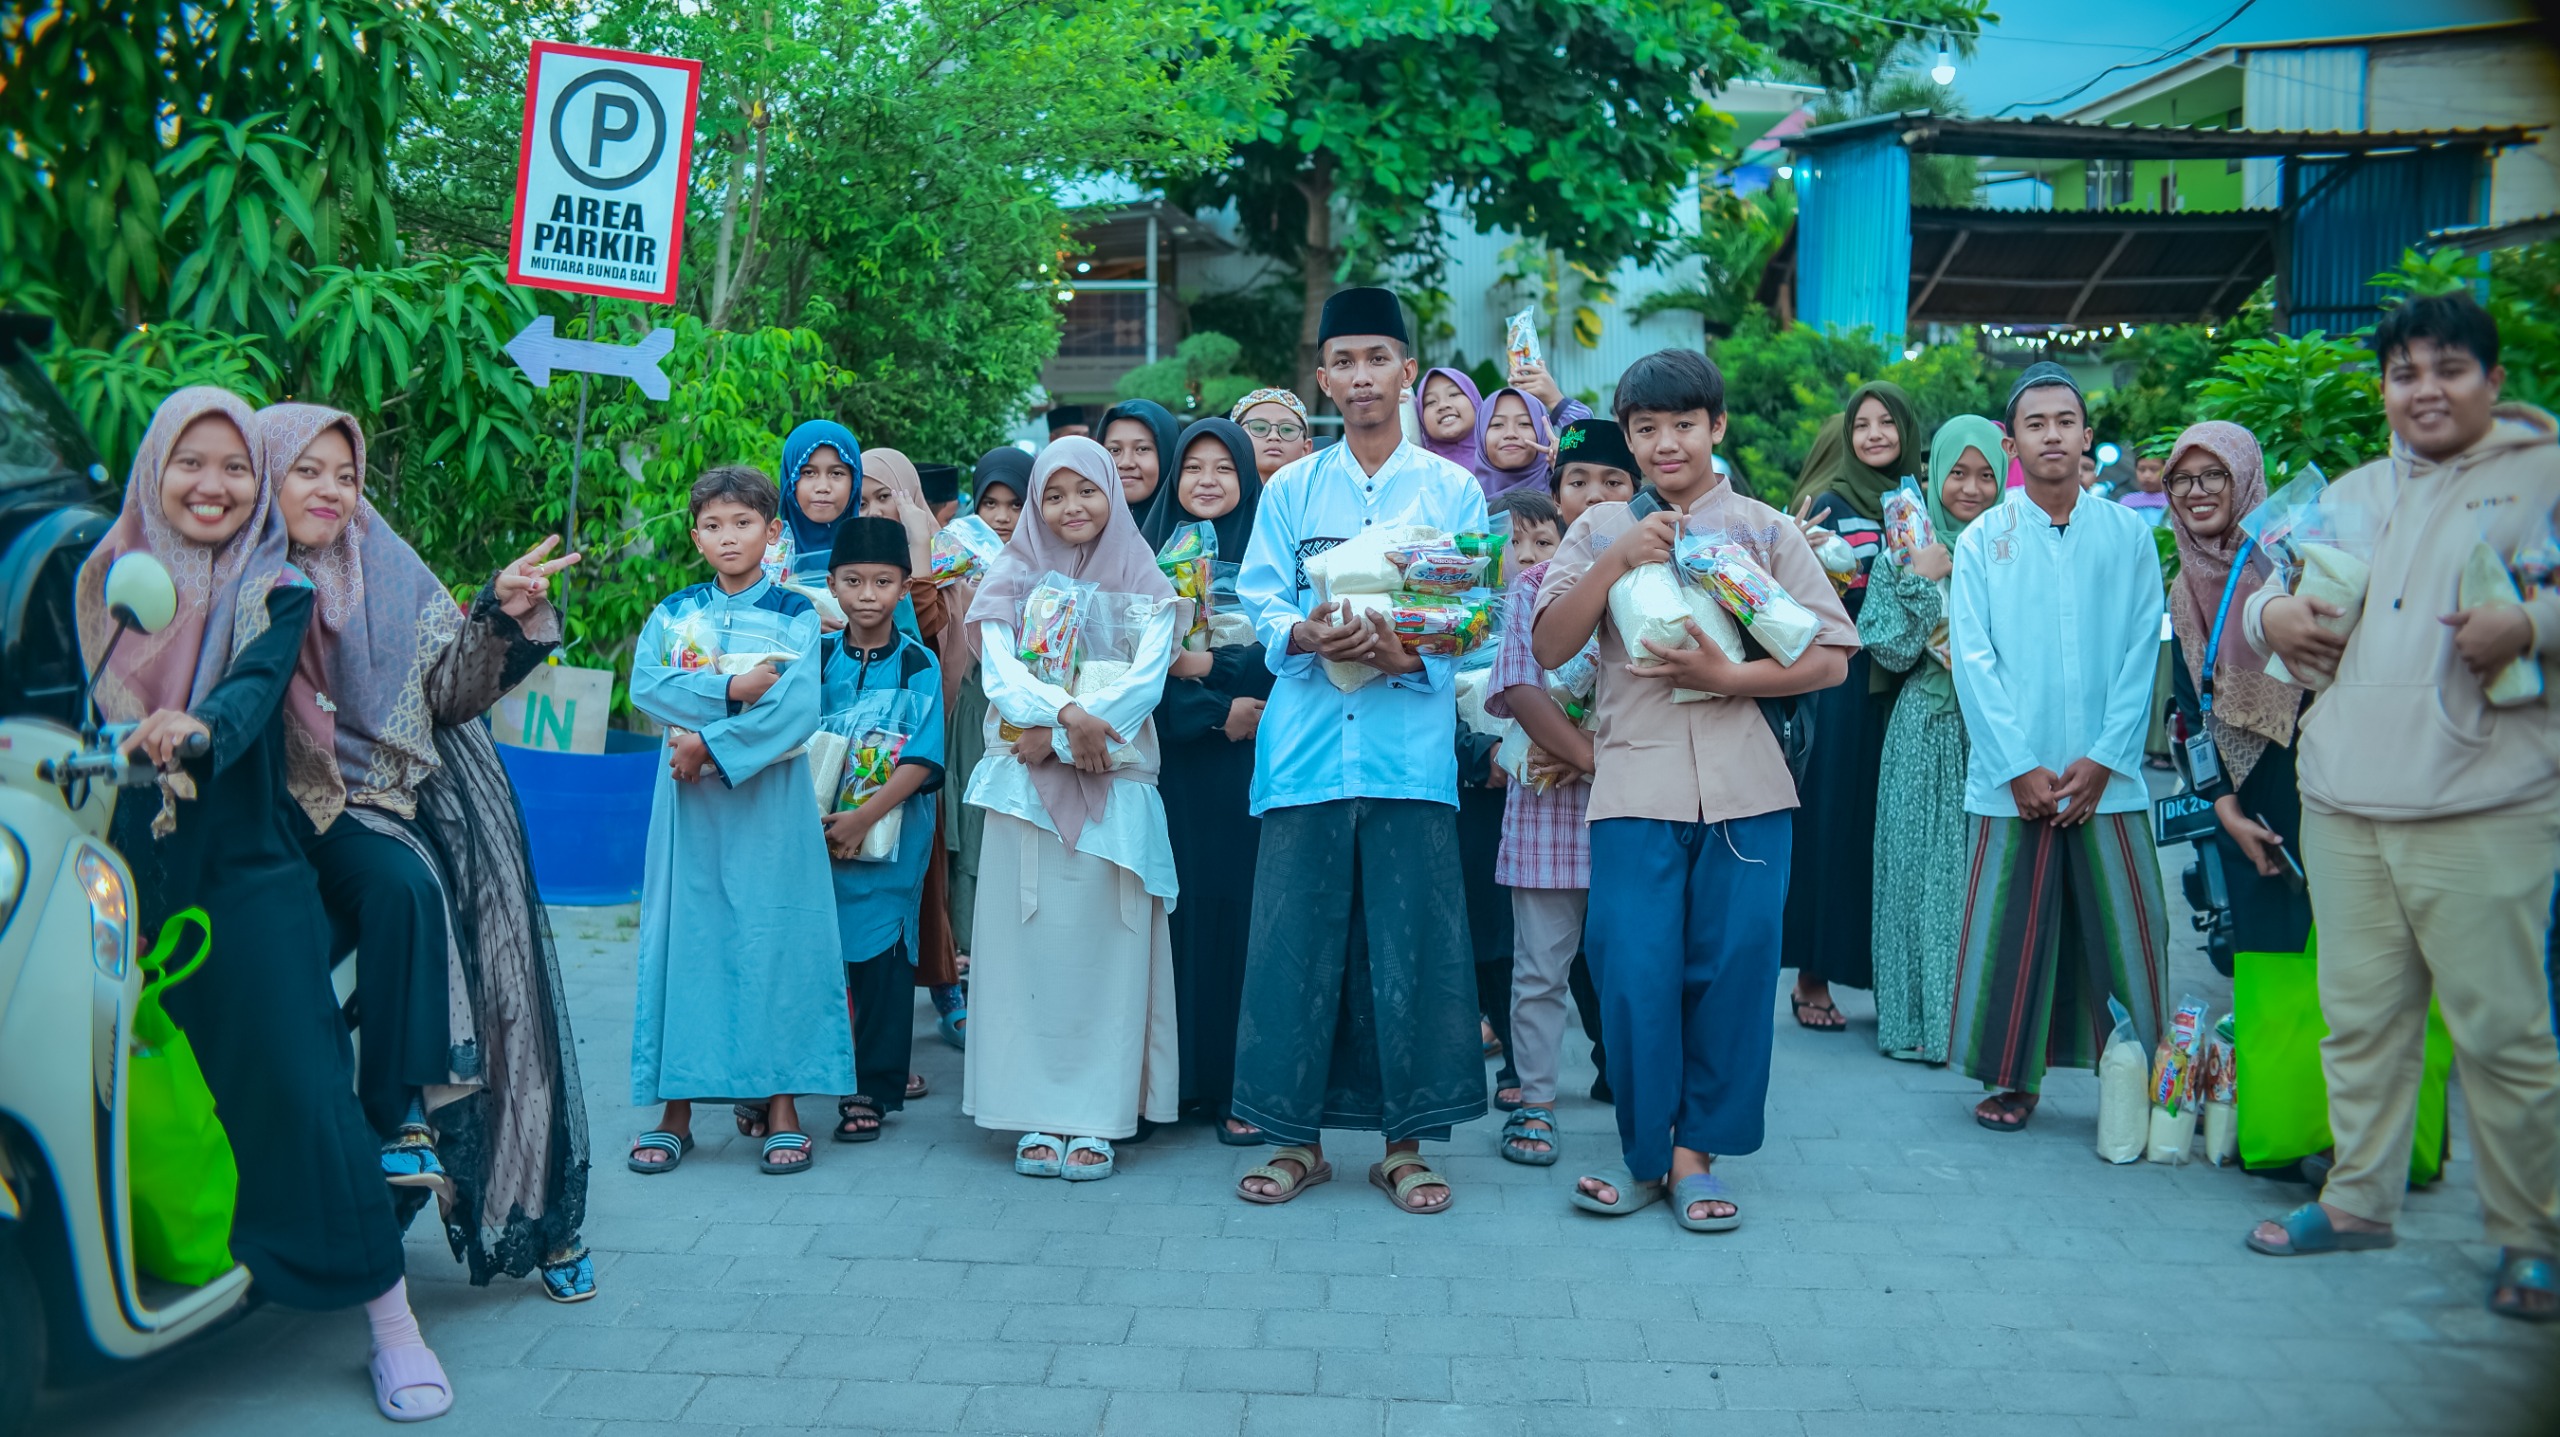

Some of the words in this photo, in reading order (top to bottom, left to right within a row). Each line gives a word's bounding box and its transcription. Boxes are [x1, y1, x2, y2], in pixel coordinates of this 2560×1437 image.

[588, 92, 639, 168] P
[550, 194, 645, 233] AREA
[533, 223, 657, 266] PARKIR
[530, 256, 584, 275] MUTIARA
[587, 263, 628, 282] BUNDA
[630, 268, 657, 284] BALI
[522, 691, 577, 752] IN
[2165, 798, 2189, 820] DK
